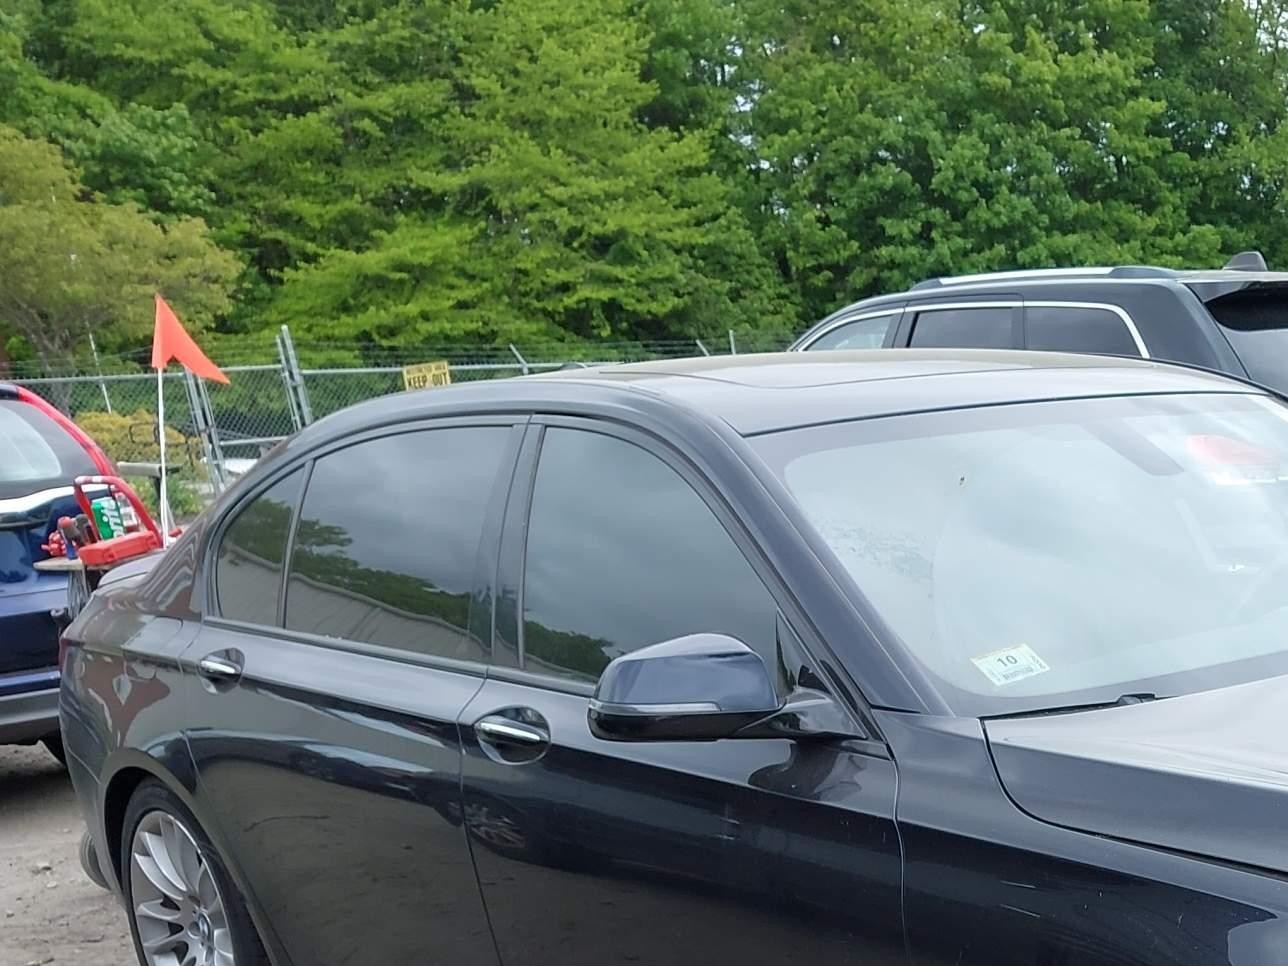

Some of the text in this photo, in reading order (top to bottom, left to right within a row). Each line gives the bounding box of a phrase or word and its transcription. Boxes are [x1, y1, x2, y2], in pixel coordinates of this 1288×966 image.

[407, 372, 448, 389] KEEP OUT
[997, 655, 1018, 667] 10
